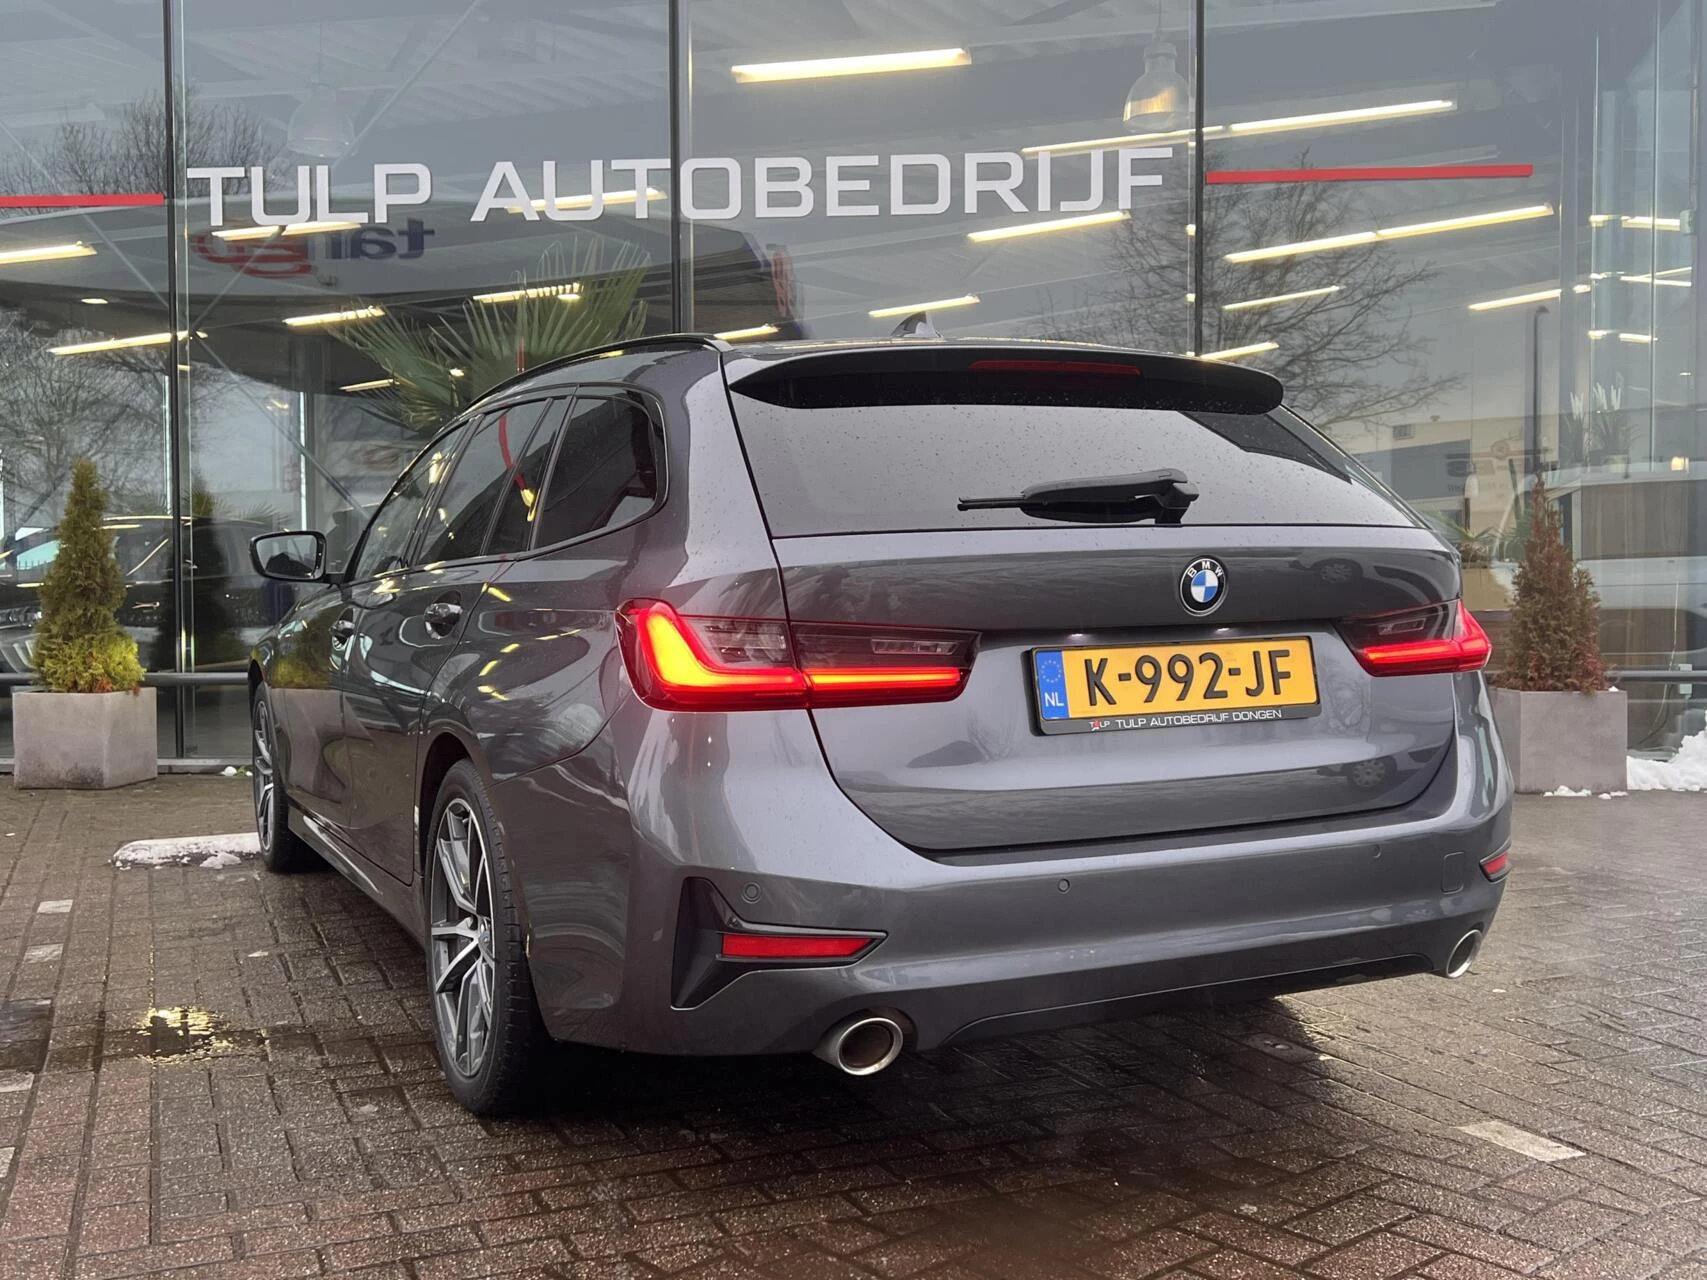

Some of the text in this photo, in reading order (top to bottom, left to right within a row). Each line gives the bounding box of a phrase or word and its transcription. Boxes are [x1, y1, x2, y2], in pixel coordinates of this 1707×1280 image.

[187, 146, 1173, 227] TULP AUTOBEDRIJF
[1187, 560, 1223, 578] BMW
[1084, 649, 1291, 706] K-992-JF
[1044, 691, 1065, 708] NL
[1115, 709, 1282, 729] TULP AUTOBEDRIJF DONGEN
